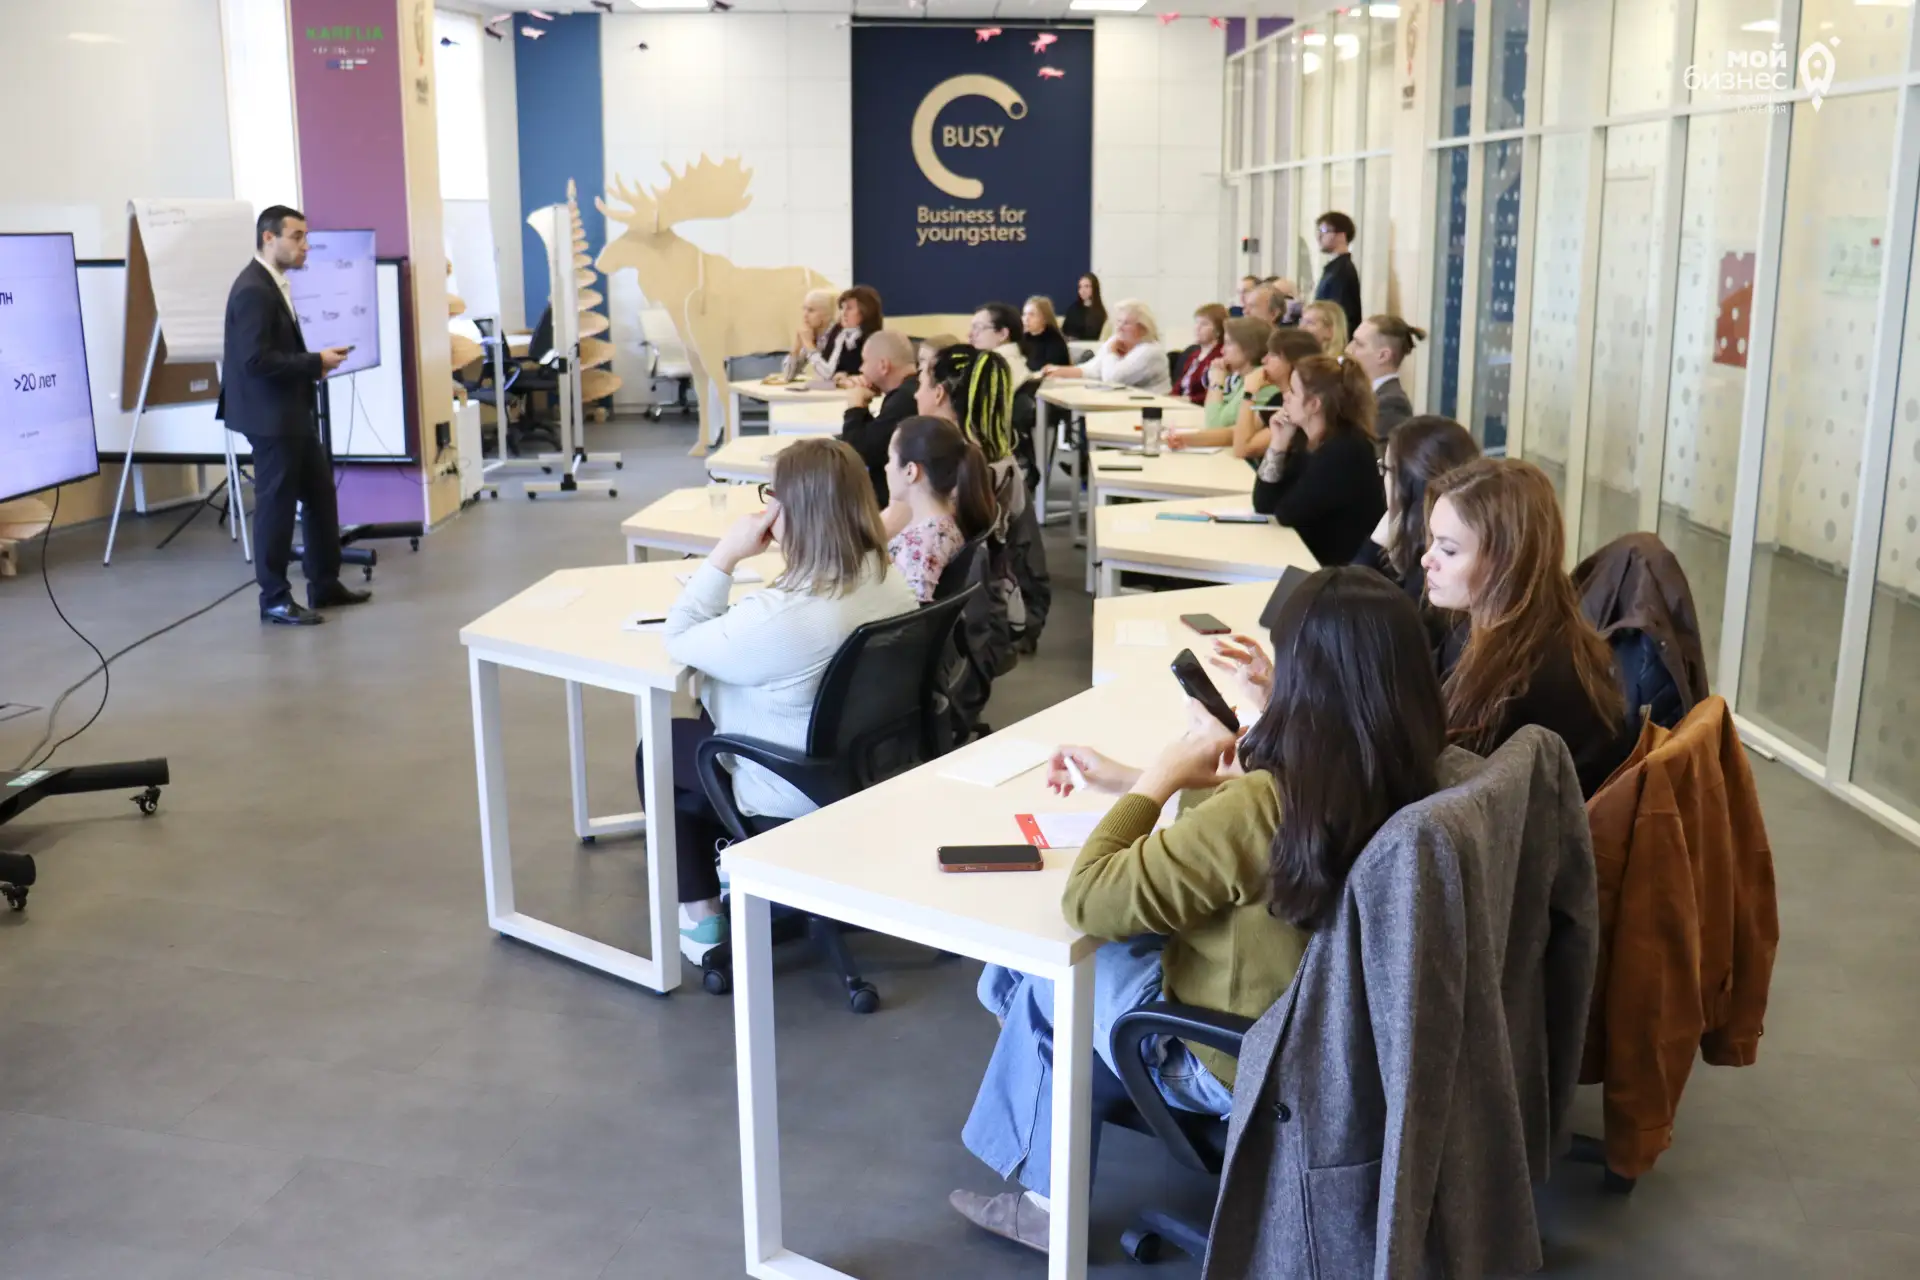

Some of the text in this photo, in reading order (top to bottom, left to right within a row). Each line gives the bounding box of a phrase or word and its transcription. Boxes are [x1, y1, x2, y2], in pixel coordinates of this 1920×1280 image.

[943, 125, 1004, 147] BUSY
[917, 205, 1026, 223] Business for
[916, 224, 1026, 247] youngsters
[13, 372, 56, 391] >20 лет
